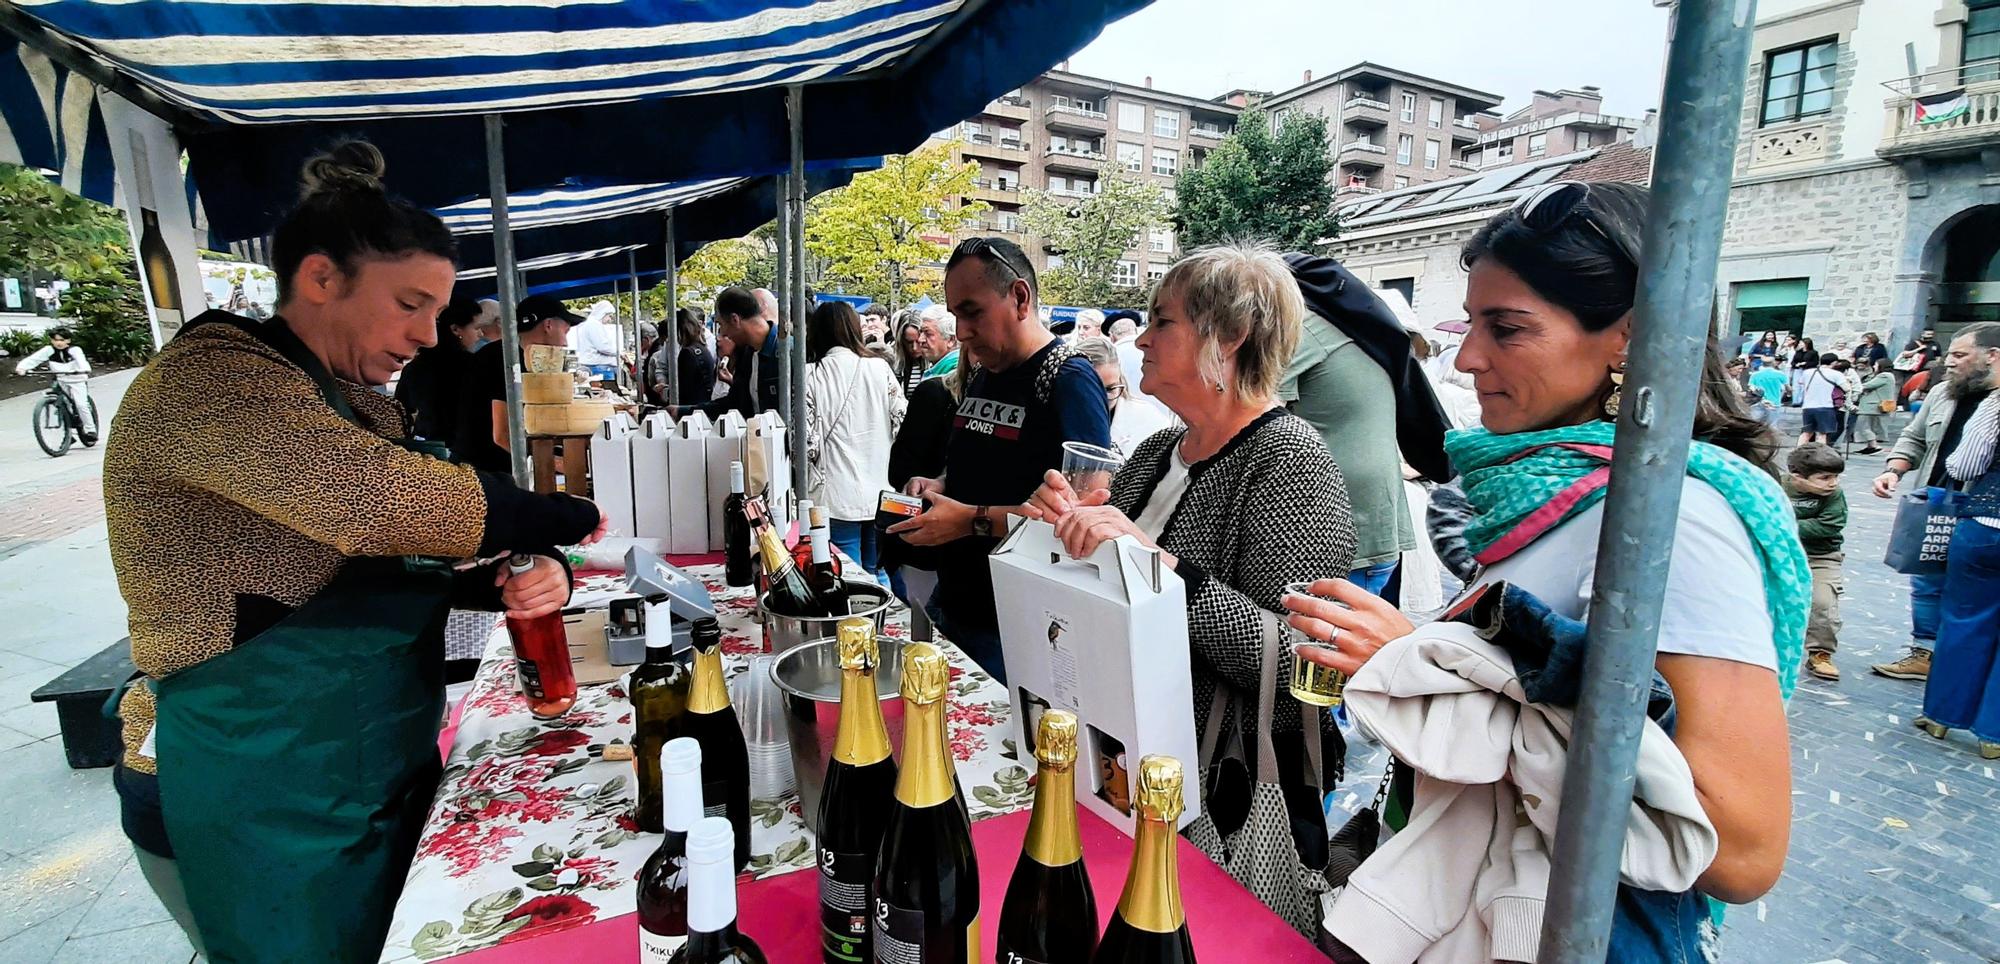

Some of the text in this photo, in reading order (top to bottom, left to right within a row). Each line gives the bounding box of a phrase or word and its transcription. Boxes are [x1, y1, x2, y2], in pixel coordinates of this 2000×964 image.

[959, 400, 1020, 424] JACK &
[965, 418, 995, 435] JONES
[820, 847, 835, 866] 13
[875, 897, 889, 919] 13
